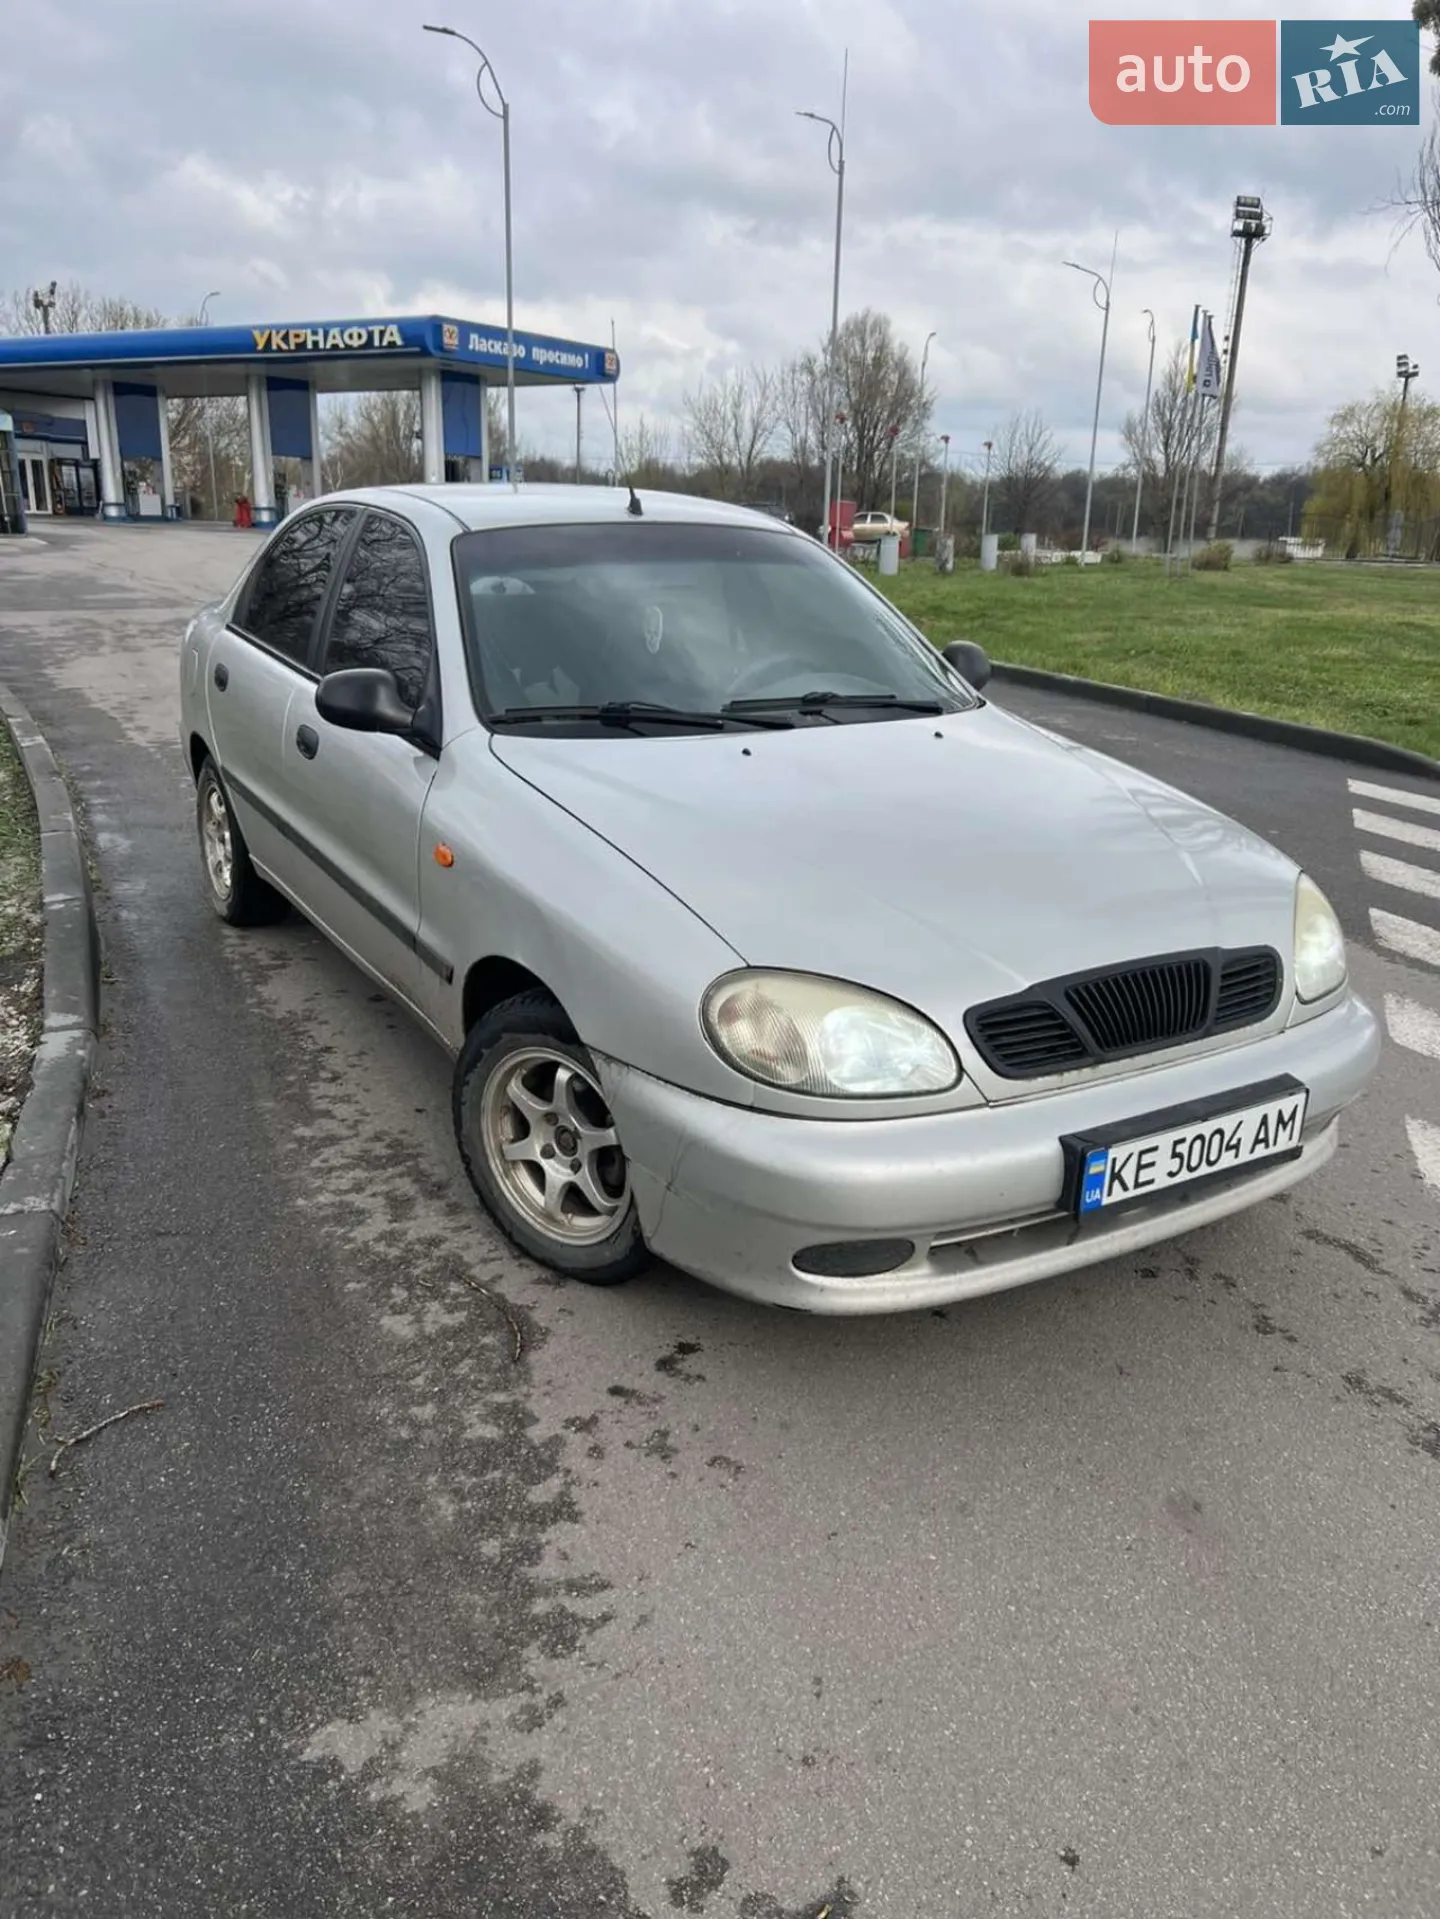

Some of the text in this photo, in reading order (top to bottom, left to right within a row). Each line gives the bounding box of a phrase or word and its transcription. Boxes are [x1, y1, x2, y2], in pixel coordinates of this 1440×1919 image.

[252, 324, 404, 350] УКРНАФТА
[1107, 1104, 1299, 1197] KE 5004 AM
[1085, 1188, 1101, 1204] UA
